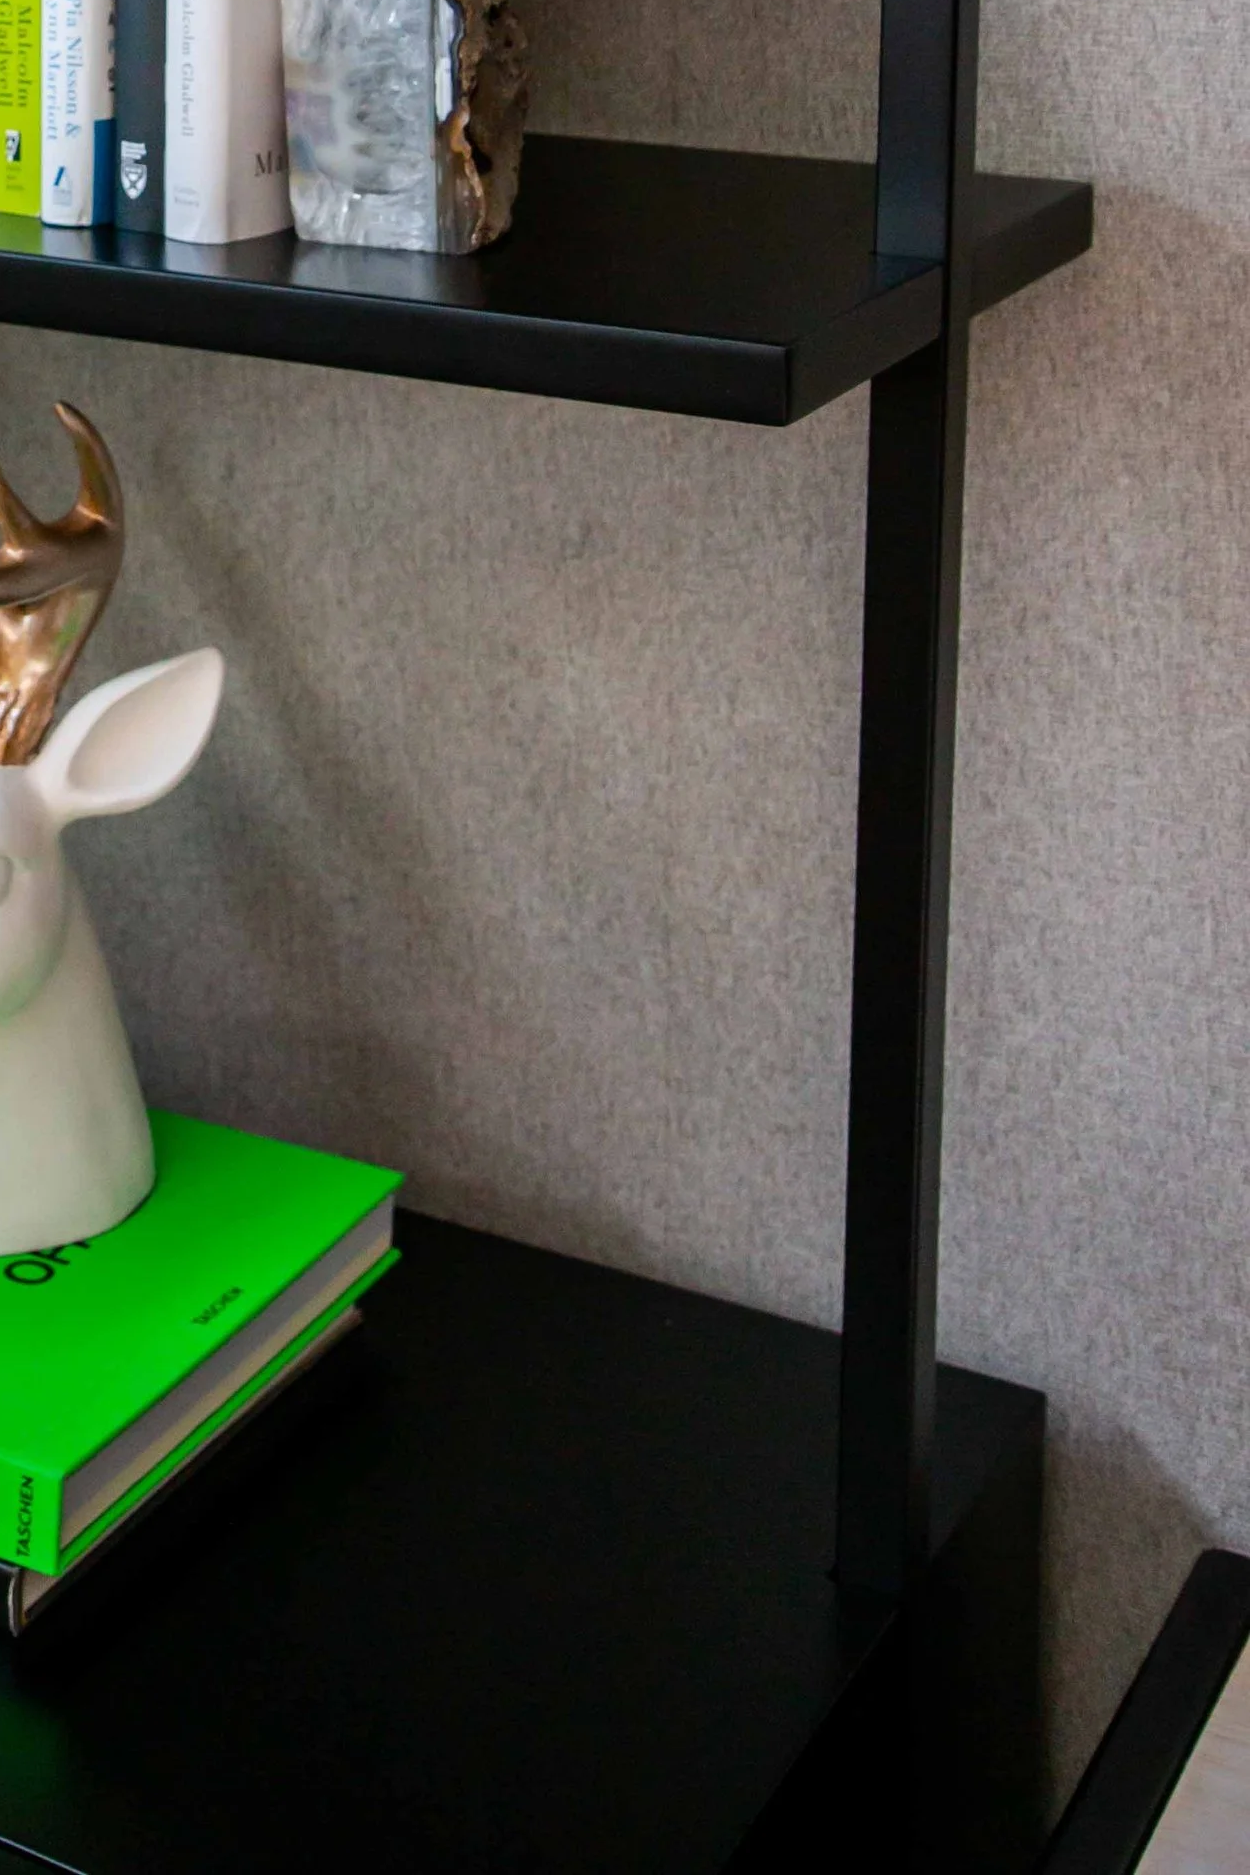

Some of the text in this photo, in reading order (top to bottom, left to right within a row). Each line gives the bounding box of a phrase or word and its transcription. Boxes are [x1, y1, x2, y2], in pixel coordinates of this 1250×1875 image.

[18, 5, 33, 108] Malcolm
[46, 50, 62, 141] Marriott
[65, 35, 84, 115] Nilsson
[65, 123, 81, 139] &
[180, 63, 196, 138] Gladwell
[15, 1474, 35, 1557] TASCHEN
